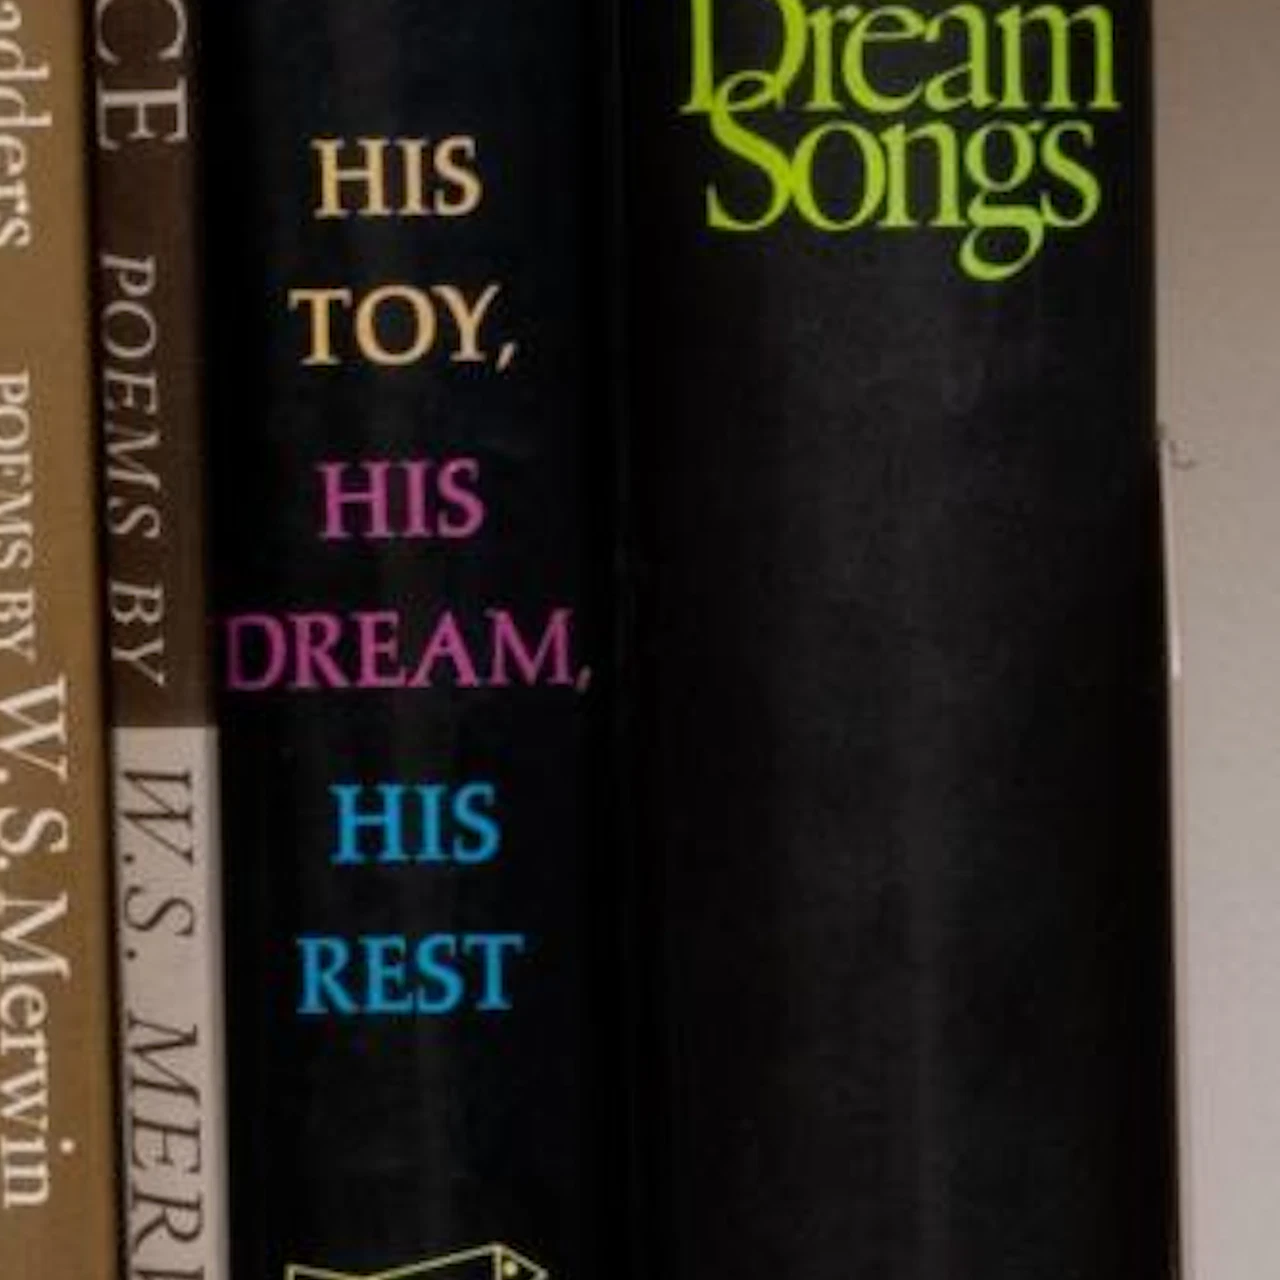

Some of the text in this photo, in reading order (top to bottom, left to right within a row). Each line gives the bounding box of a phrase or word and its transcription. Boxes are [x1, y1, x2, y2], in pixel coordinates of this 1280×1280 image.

[310, 135, 484, 219] HIS
[705, 70, 1101, 283] Songs
[287, 283, 518, 373] TOY,
[99, 253, 167, 687] POEMS BY
[317, 457, 486, 541] HIS
[224, 607, 592, 693] DREAM,
[329, 780, 503, 865] HIS
[295, 932, 527, 1015] REST
